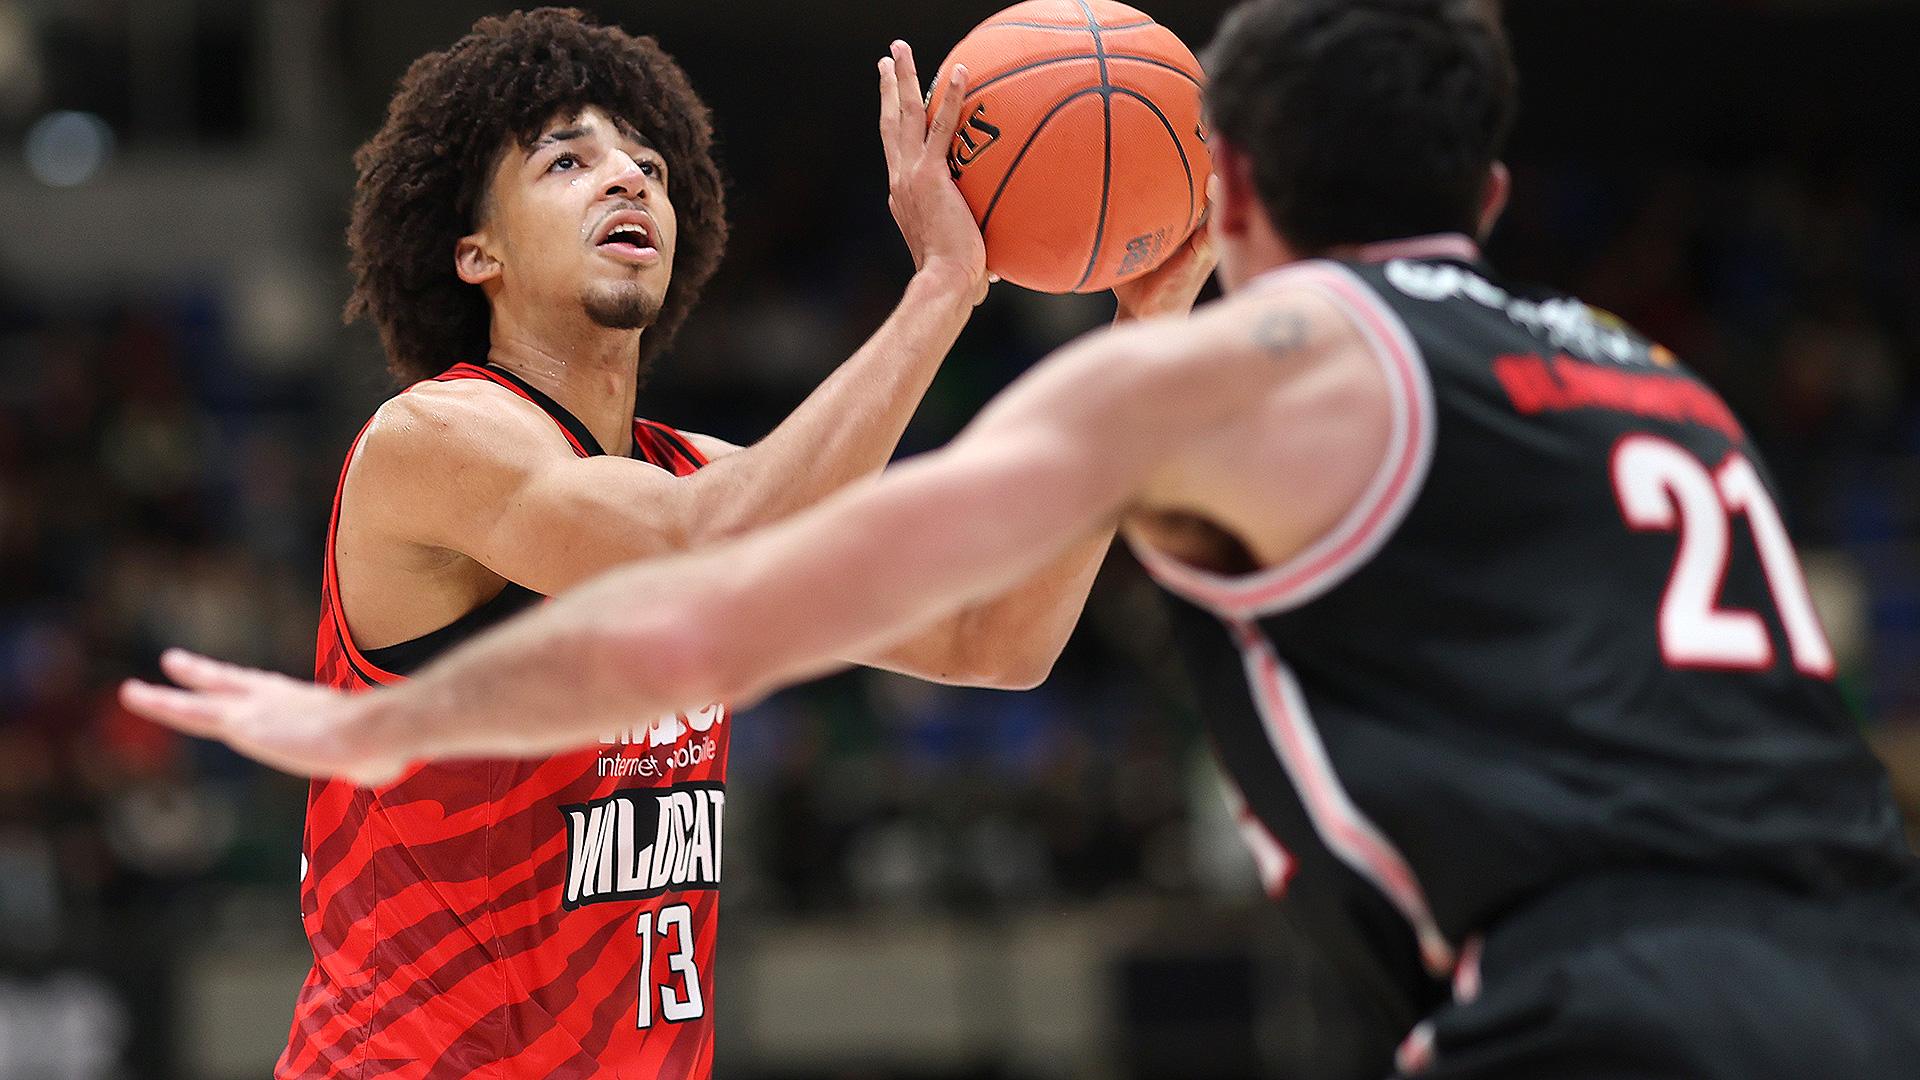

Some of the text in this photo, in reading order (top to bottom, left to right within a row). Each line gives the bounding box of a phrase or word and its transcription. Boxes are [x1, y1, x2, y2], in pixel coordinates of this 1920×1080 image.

[1608, 432, 1838, 682] 21
[598, 735, 716, 777] internet obile
[635, 902, 705, 1029] 13
